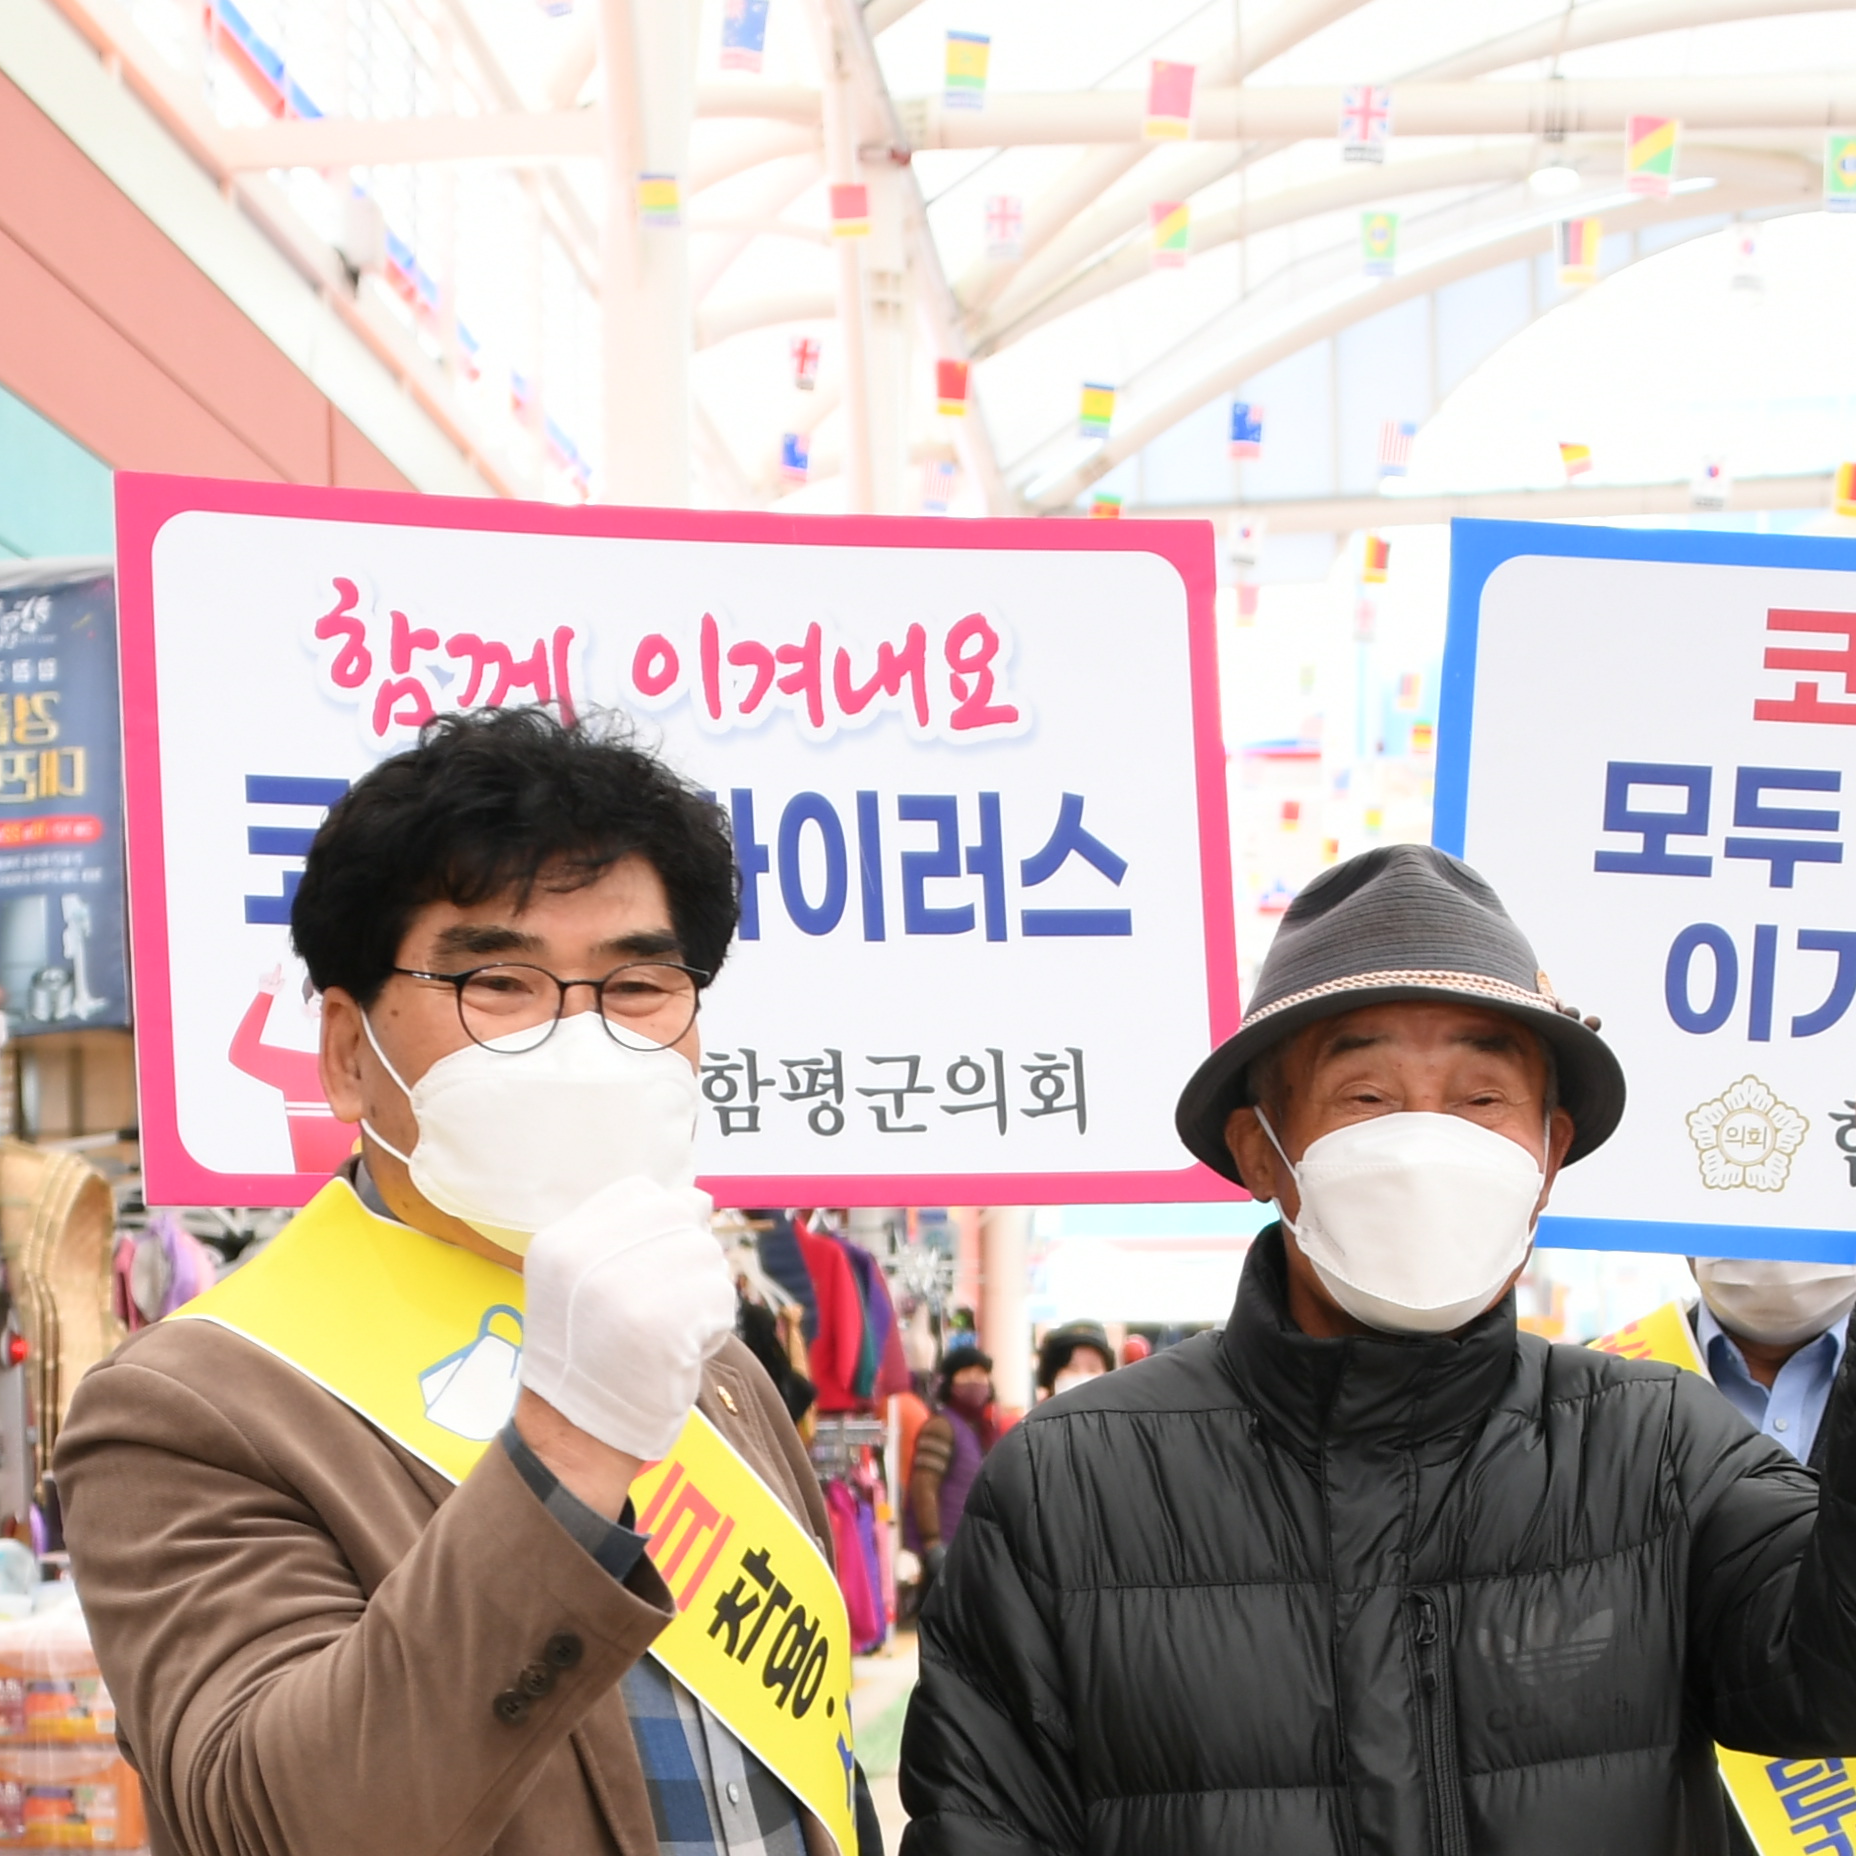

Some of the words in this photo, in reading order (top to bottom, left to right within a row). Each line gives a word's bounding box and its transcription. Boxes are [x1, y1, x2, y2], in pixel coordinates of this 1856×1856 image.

[315, 575, 577, 737] 함께
[630, 611, 1020, 731] 이겨내요
[1593, 759, 1844, 890] 모두
[700, 1046, 1090, 1137] 함평군의회
[1723, 1123, 1770, 1151] 의회
